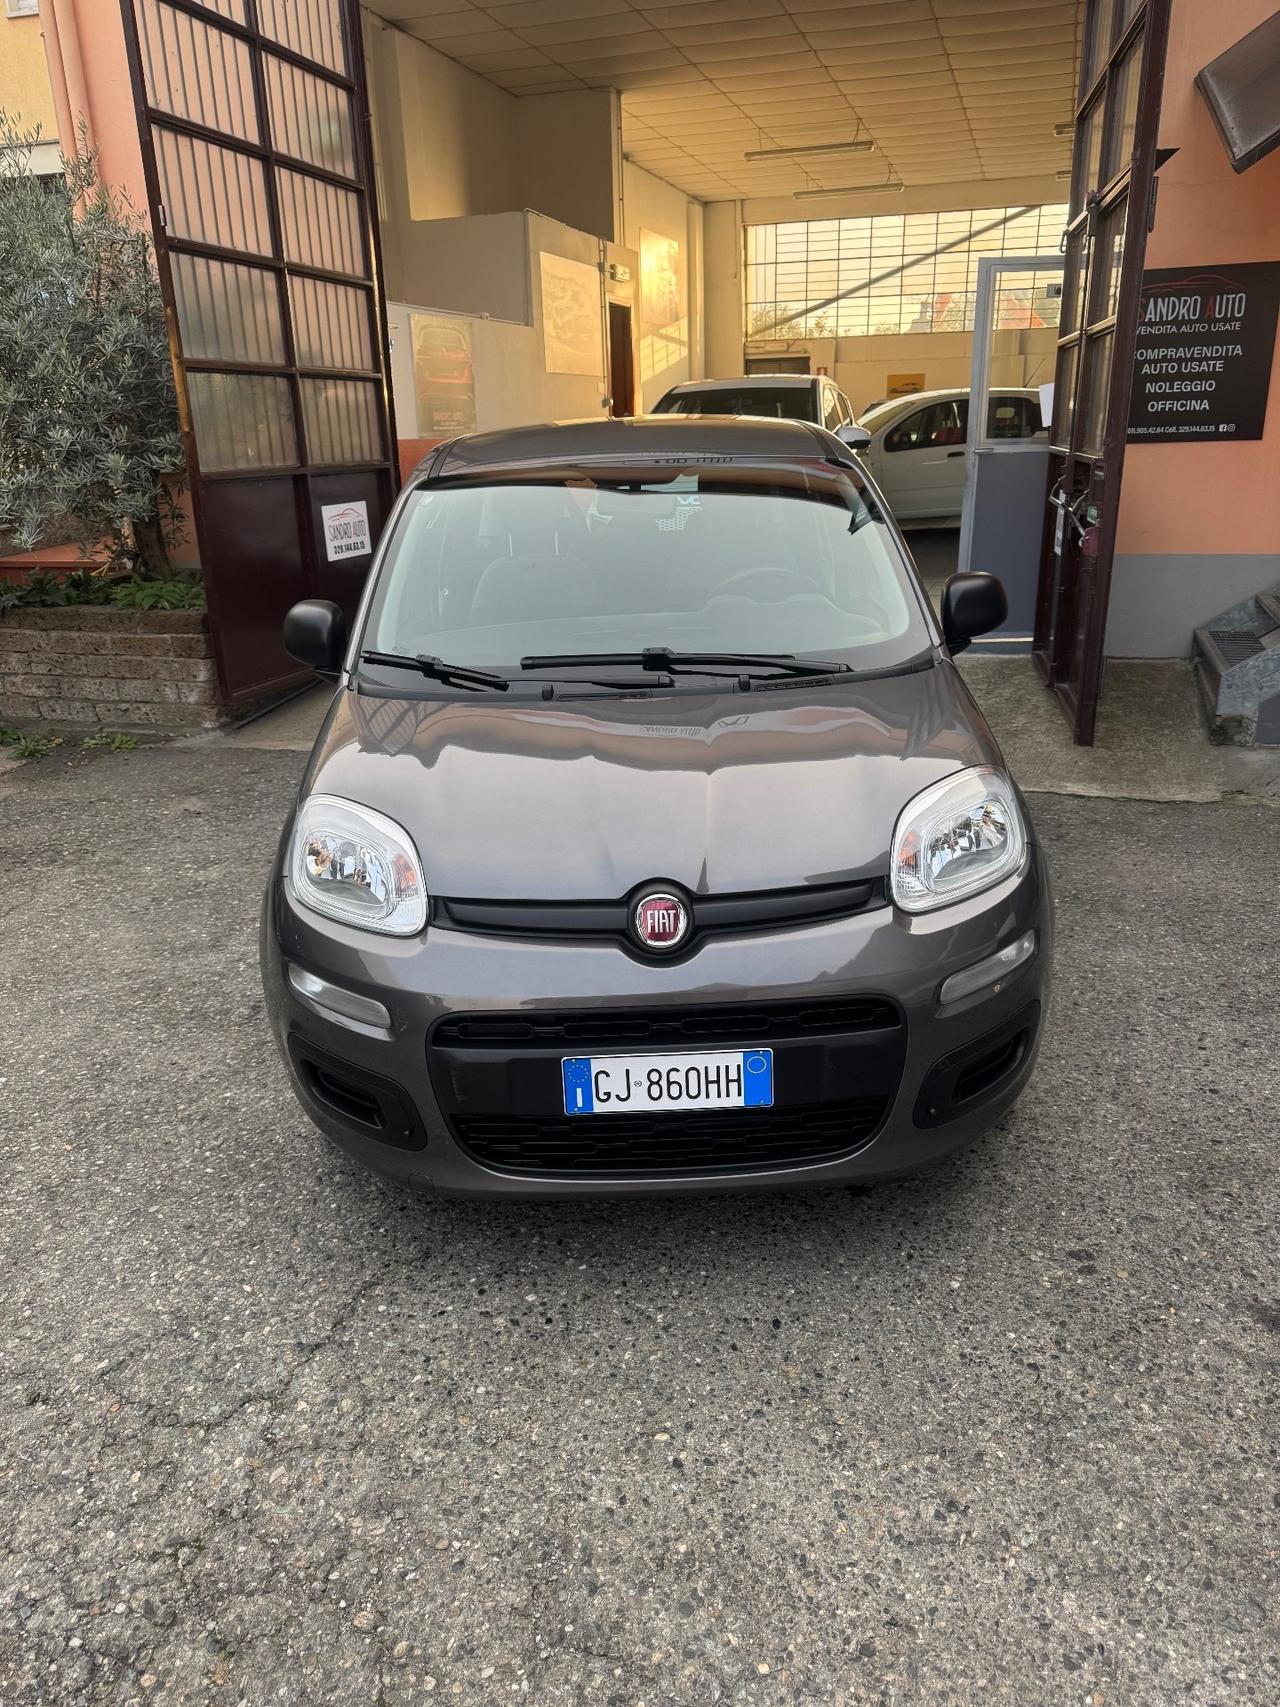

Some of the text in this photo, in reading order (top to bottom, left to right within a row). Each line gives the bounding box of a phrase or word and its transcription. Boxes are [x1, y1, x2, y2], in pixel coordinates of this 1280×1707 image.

[1205, 293, 1247, 319] AUTO
[1179, 323, 1208, 333] AUTO
[1211, 321, 1242, 331] USATE
[1133, 344, 1243, 360] OMPRAVENDITA
[1141, 360, 1225, 375] AUTO USATE
[1145, 380, 1216, 393] NOLEGGIO
[1147, 399, 1210, 412] OFFICINA
[646, 909, 676, 933] FIAT
[594, 1068, 631, 1103] GJ
[646, 1064, 742, 1101] 860HH
